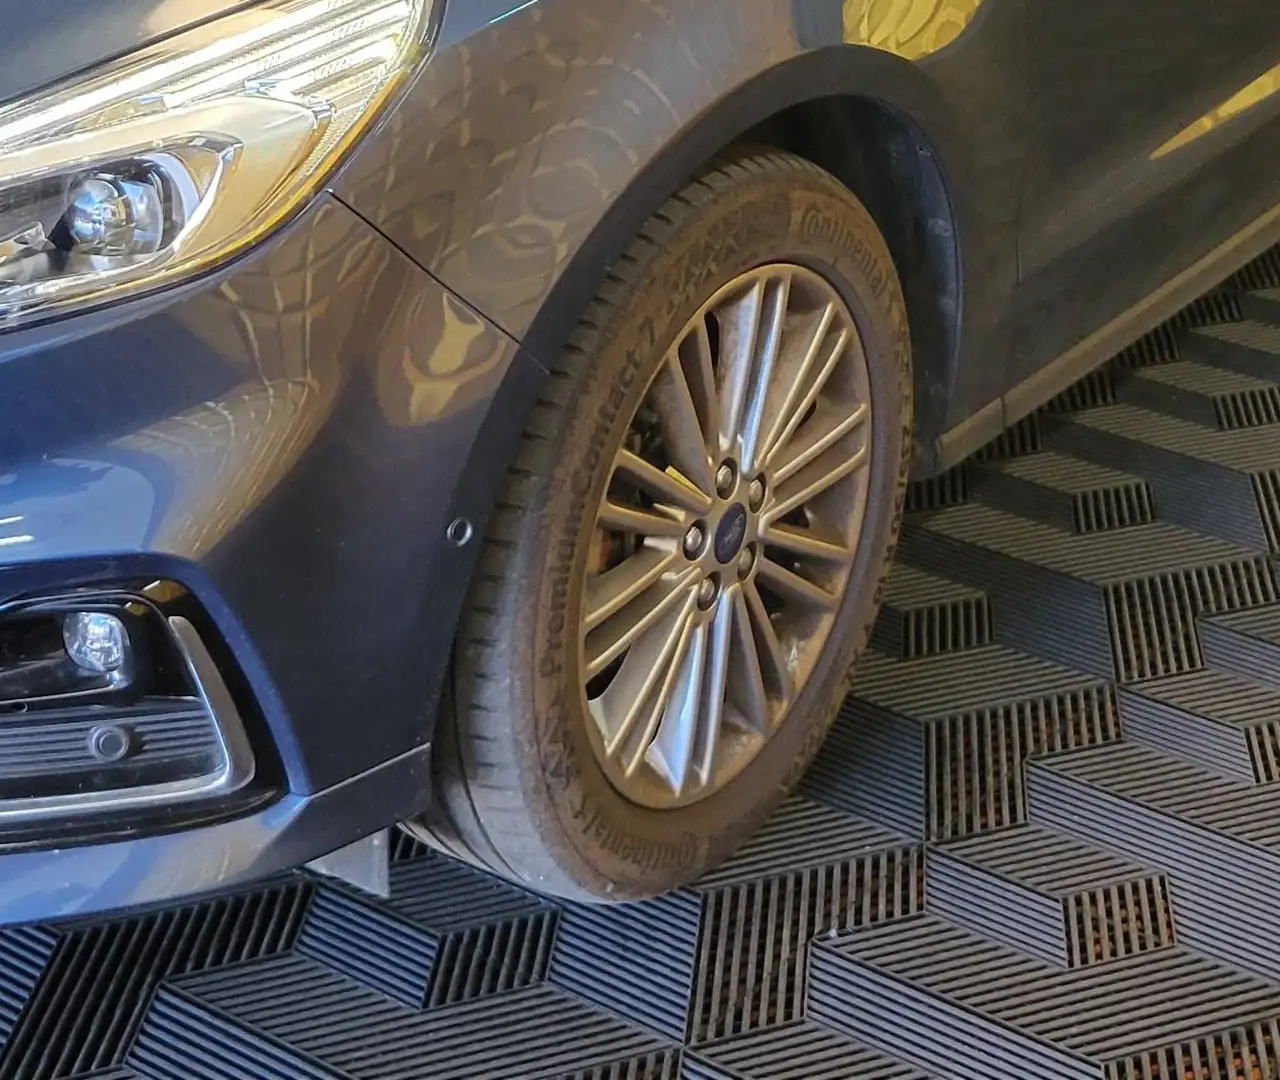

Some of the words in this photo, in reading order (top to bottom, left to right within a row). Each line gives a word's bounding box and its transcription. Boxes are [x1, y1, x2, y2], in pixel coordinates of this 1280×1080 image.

[800, 201, 888, 300] Continental
[540, 348, 641, 678] PremiumContact
[582, 808, 699, 874] Continental
